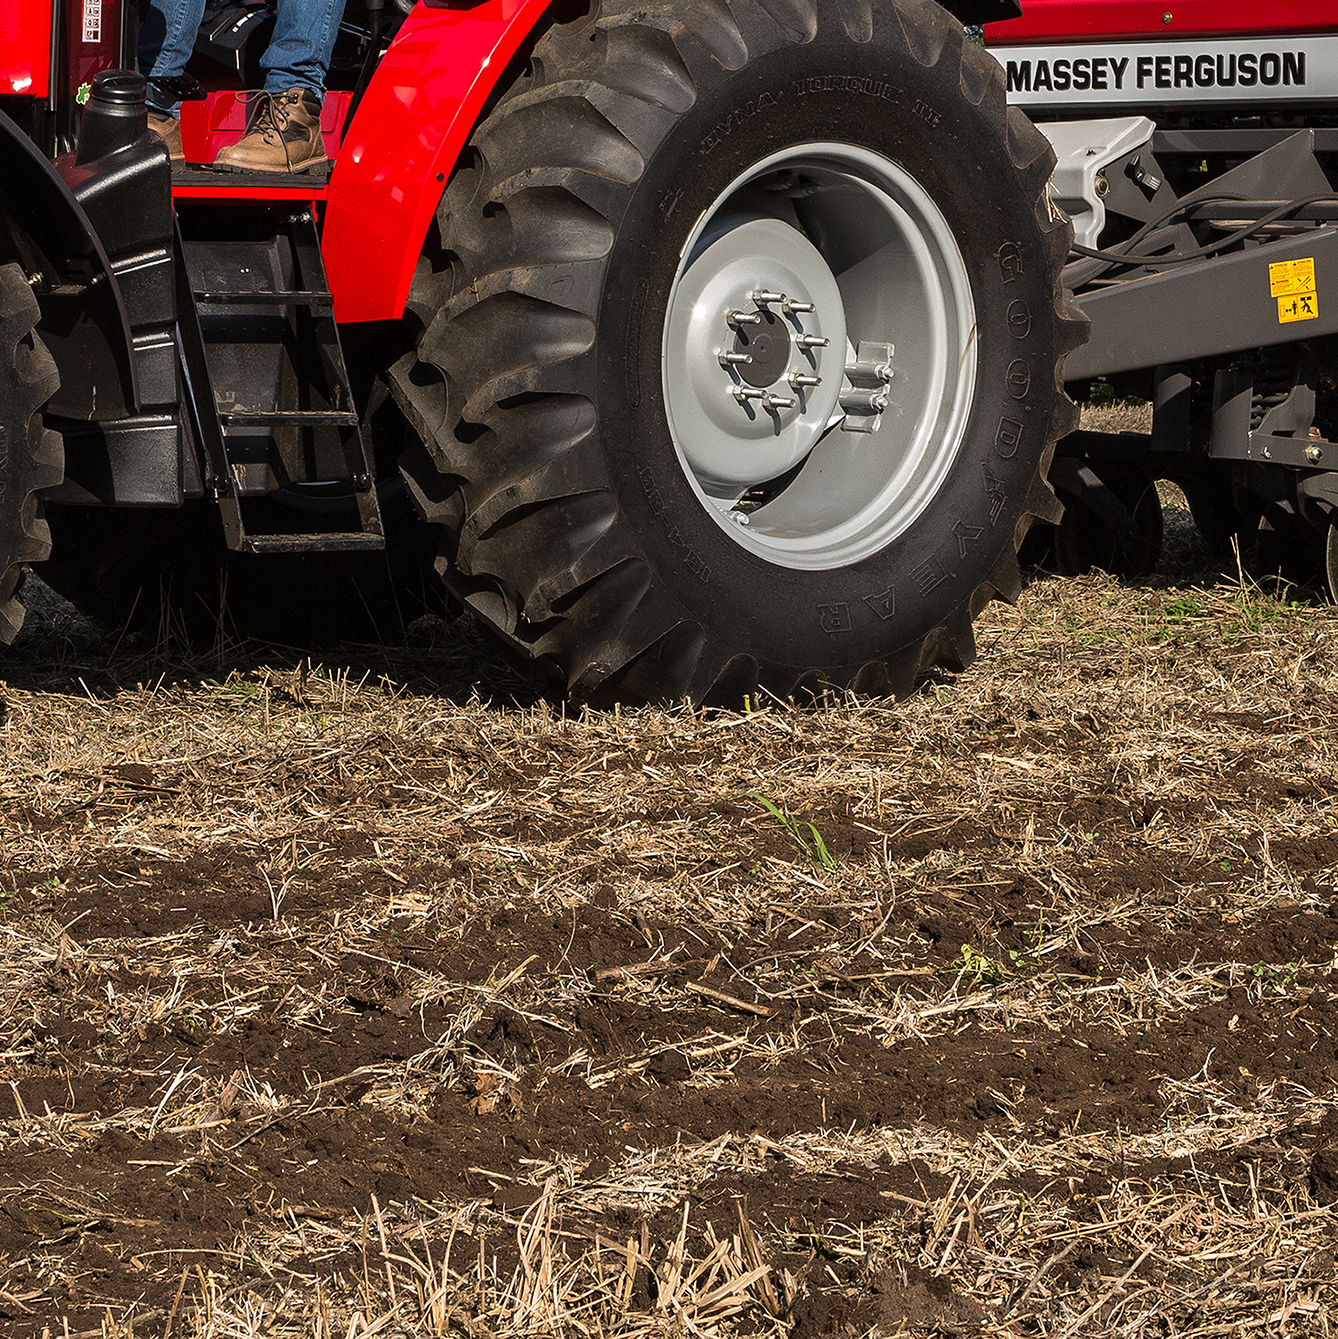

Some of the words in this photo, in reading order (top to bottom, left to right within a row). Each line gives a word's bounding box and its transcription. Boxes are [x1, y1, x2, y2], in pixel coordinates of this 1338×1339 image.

[1005, 55, 1130, 94] MASSEY
[1135, 51, 1307, 90] FERGUSON
[699, 90, 779, 156] DYNA
[792, 74, 905, 105] TORQUE
